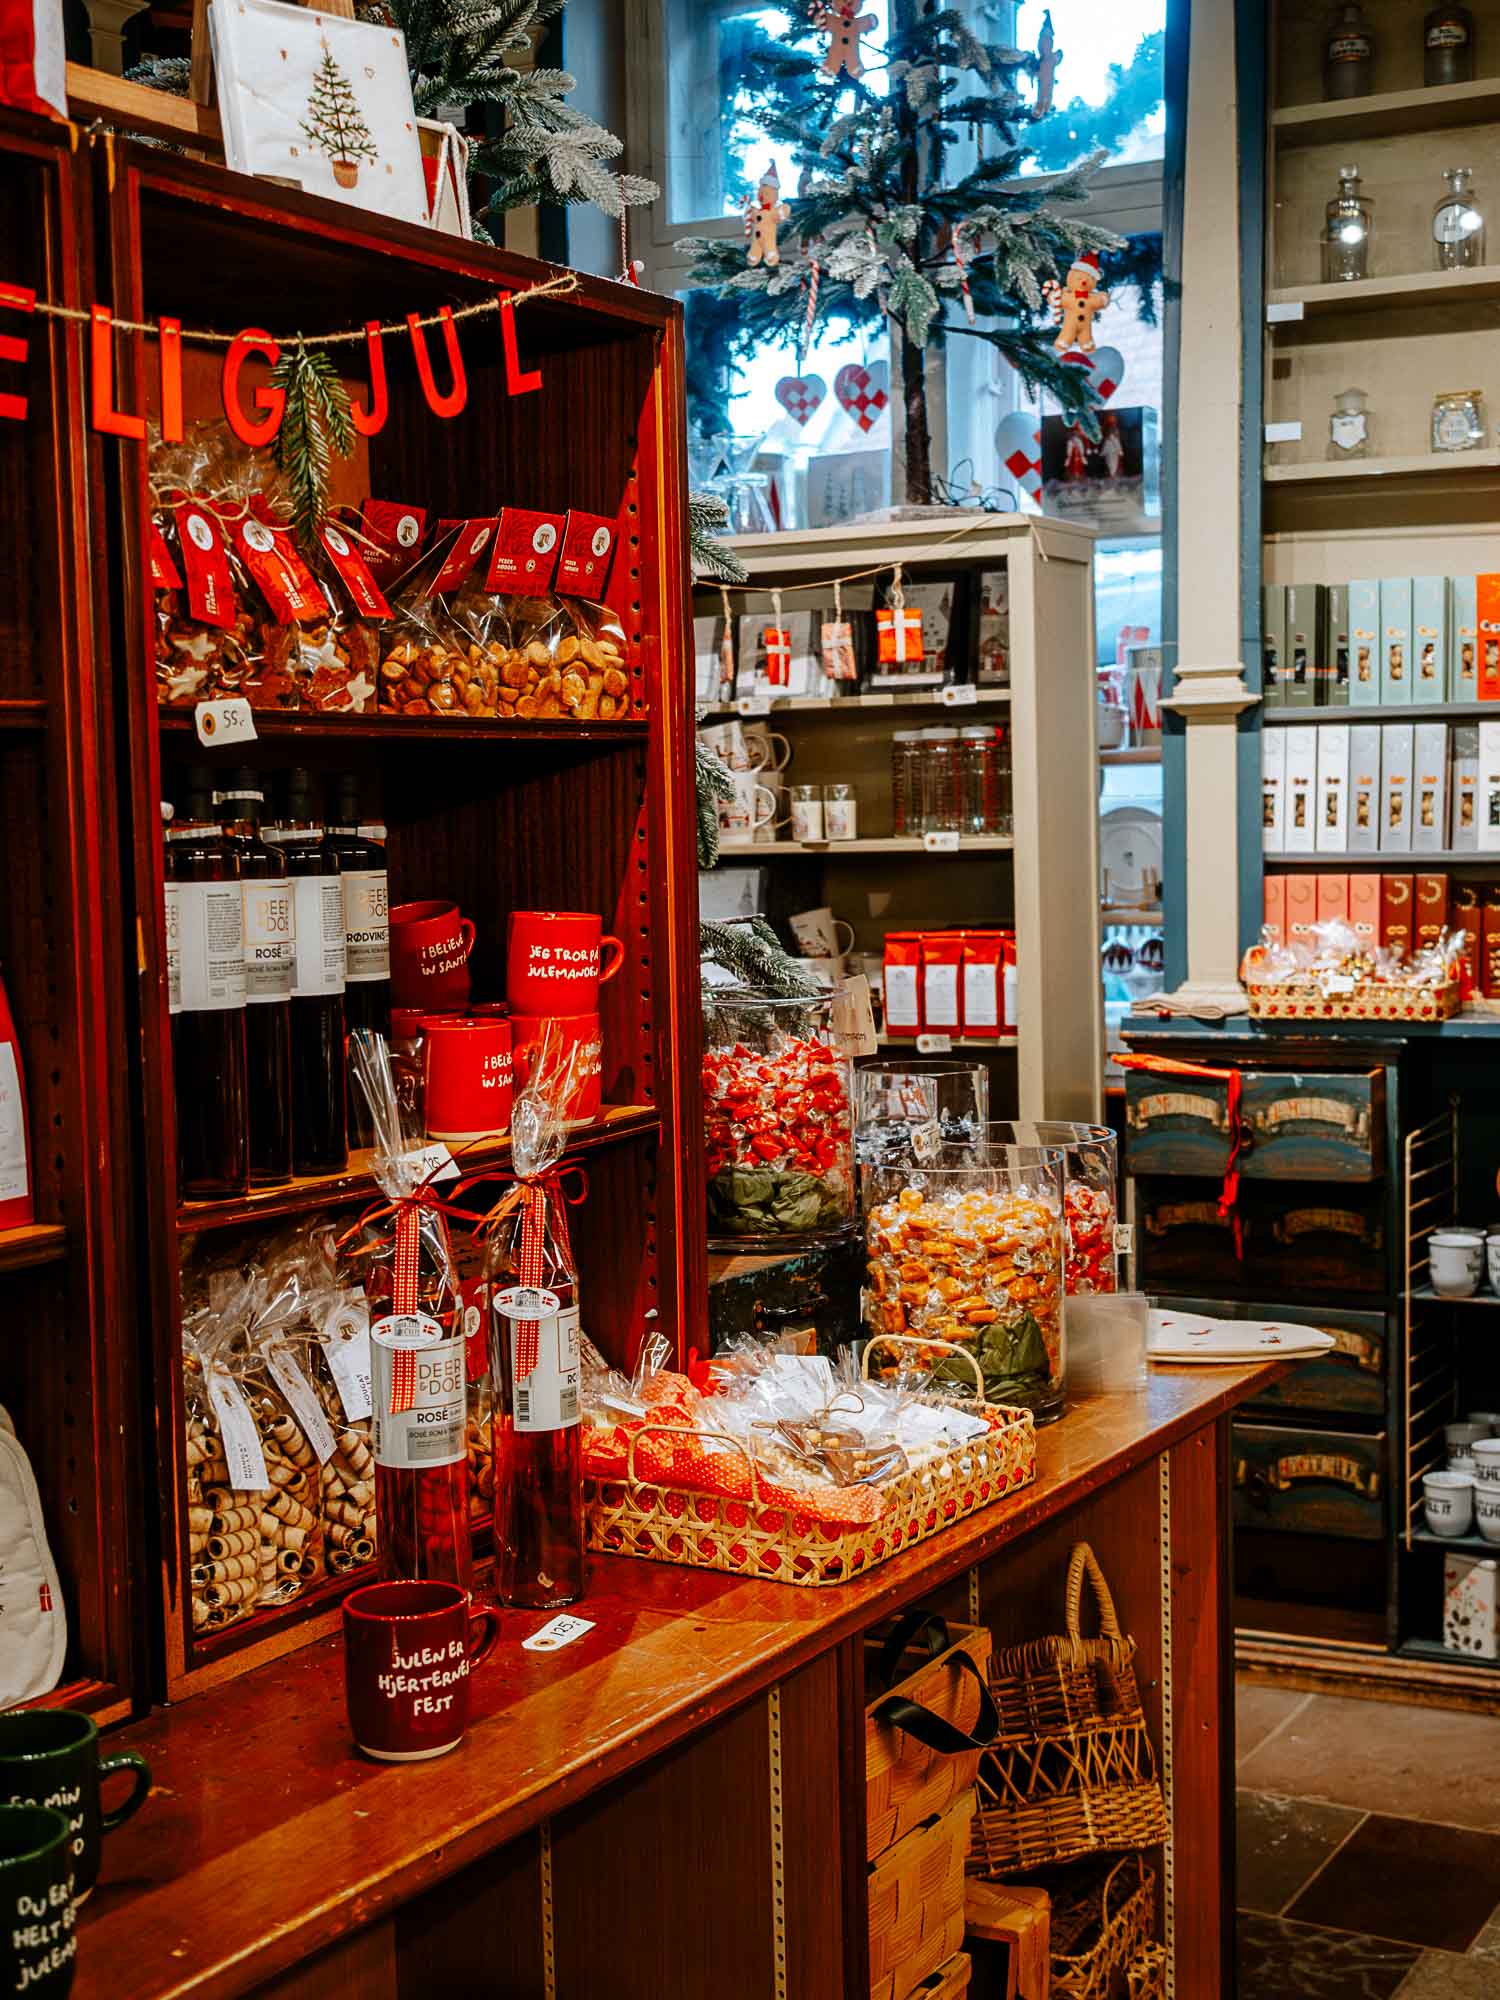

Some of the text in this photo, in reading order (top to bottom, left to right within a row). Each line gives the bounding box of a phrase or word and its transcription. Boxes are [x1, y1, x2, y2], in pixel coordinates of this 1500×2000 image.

[350, 290, 544, 437] JUL
[255, 943, 282, 959] ROSÉ
[418, 1358, 461, 1379] DEER
[416, 1407, 448, 1424] ROSÉ
[448, 1640, 465, 1659] ER
[413, 1695, 453, 1717] FEST
[17, 1895, 48, 1917] DU
[13, 1919, 62, 1949] HELT
